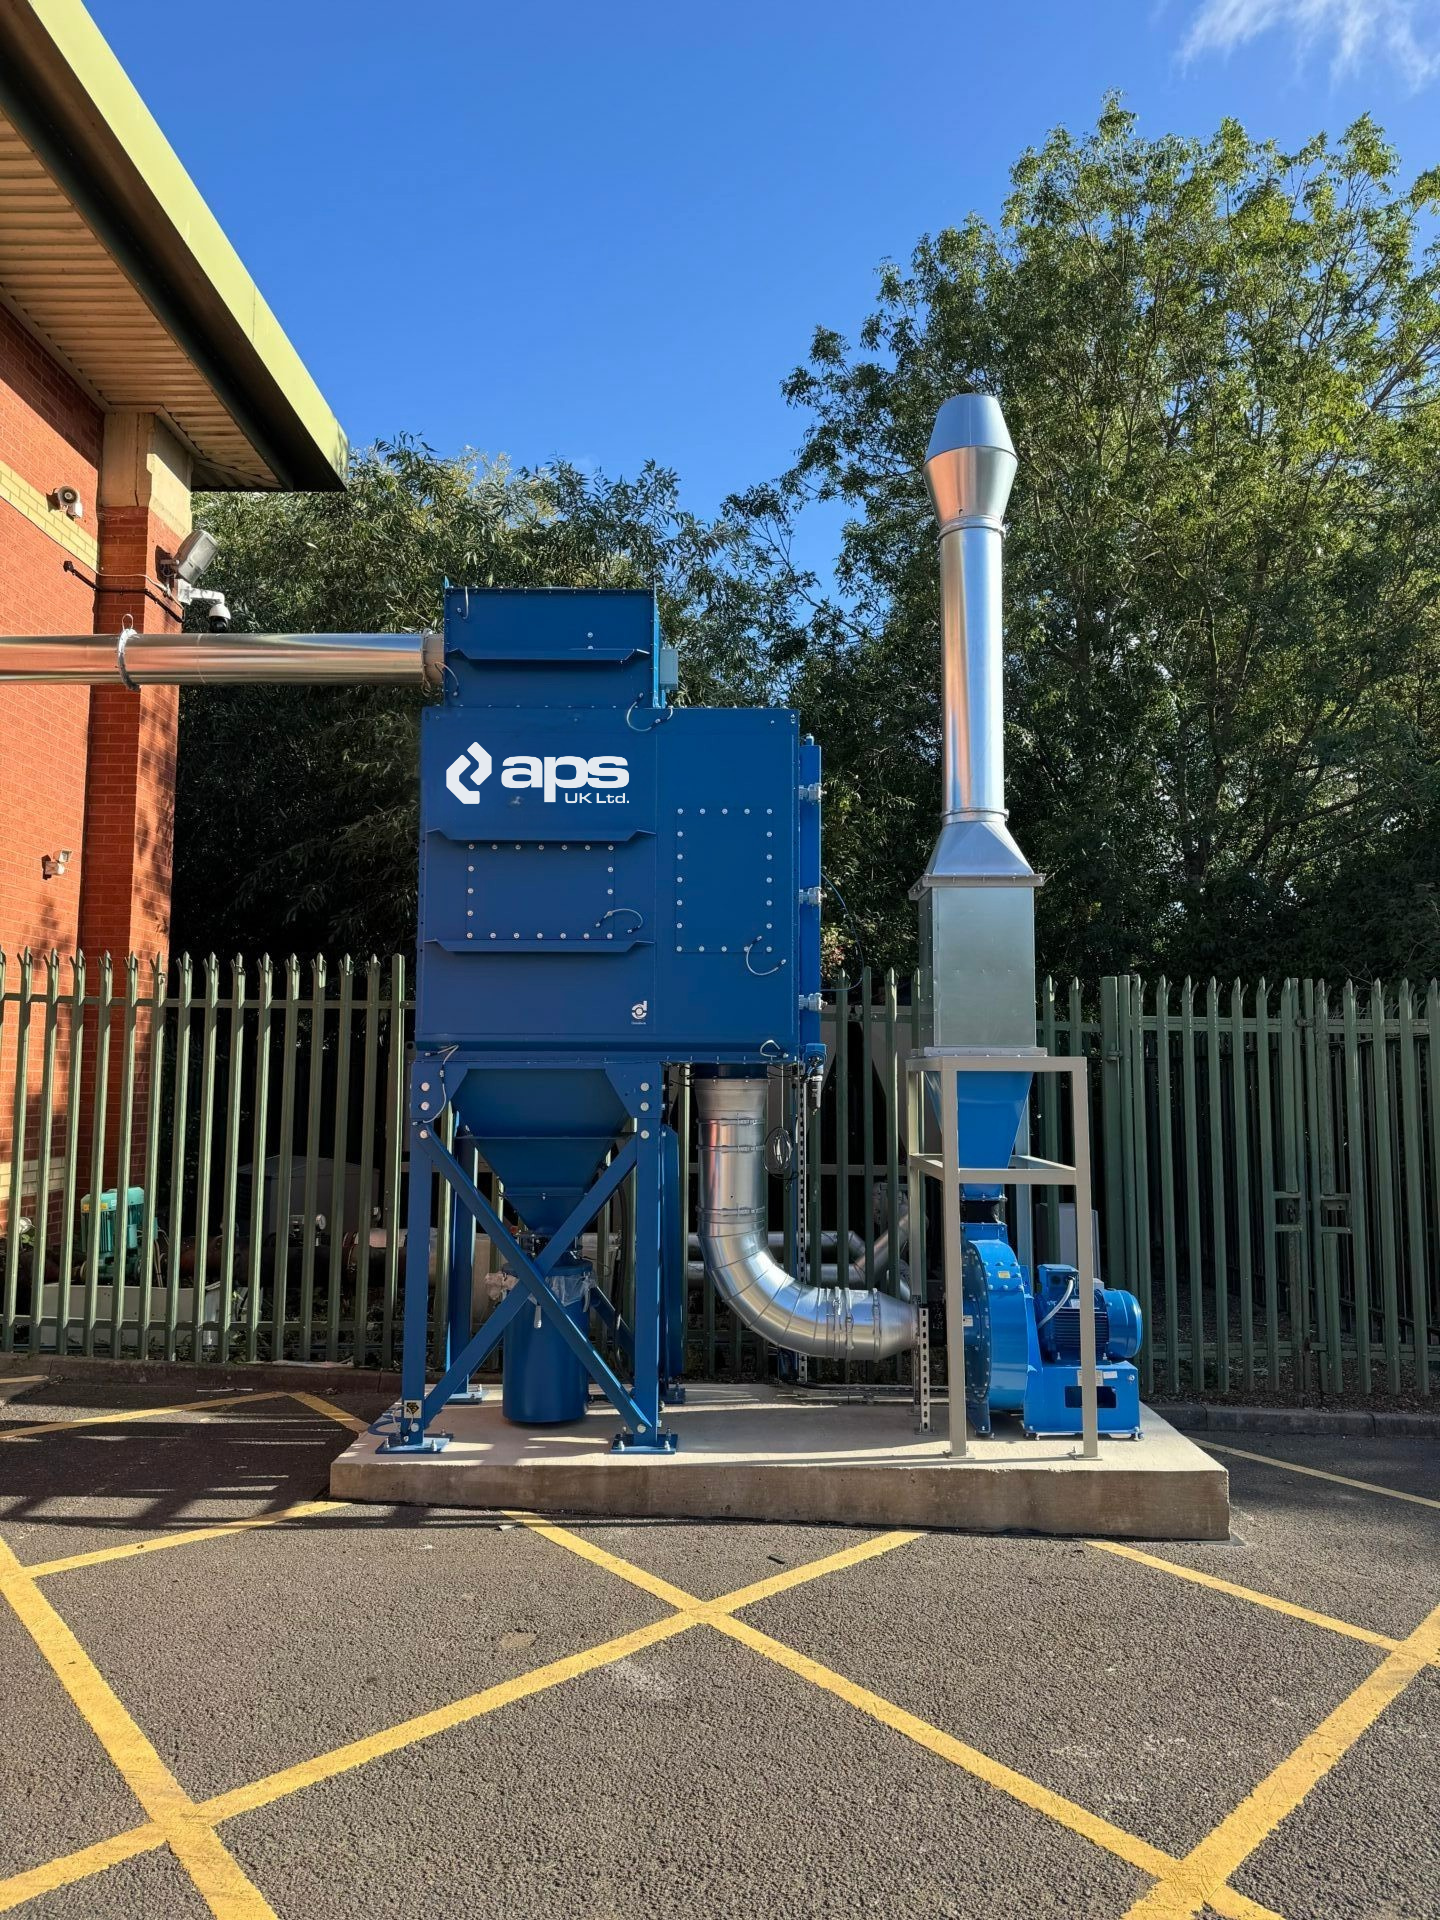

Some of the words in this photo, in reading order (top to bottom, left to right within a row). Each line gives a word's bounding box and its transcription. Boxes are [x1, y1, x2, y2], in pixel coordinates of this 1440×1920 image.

[501, 756, 629, 803] aps
[565, 793, 592, 803] UK
[596, 792, 629, 804] Ltd.
